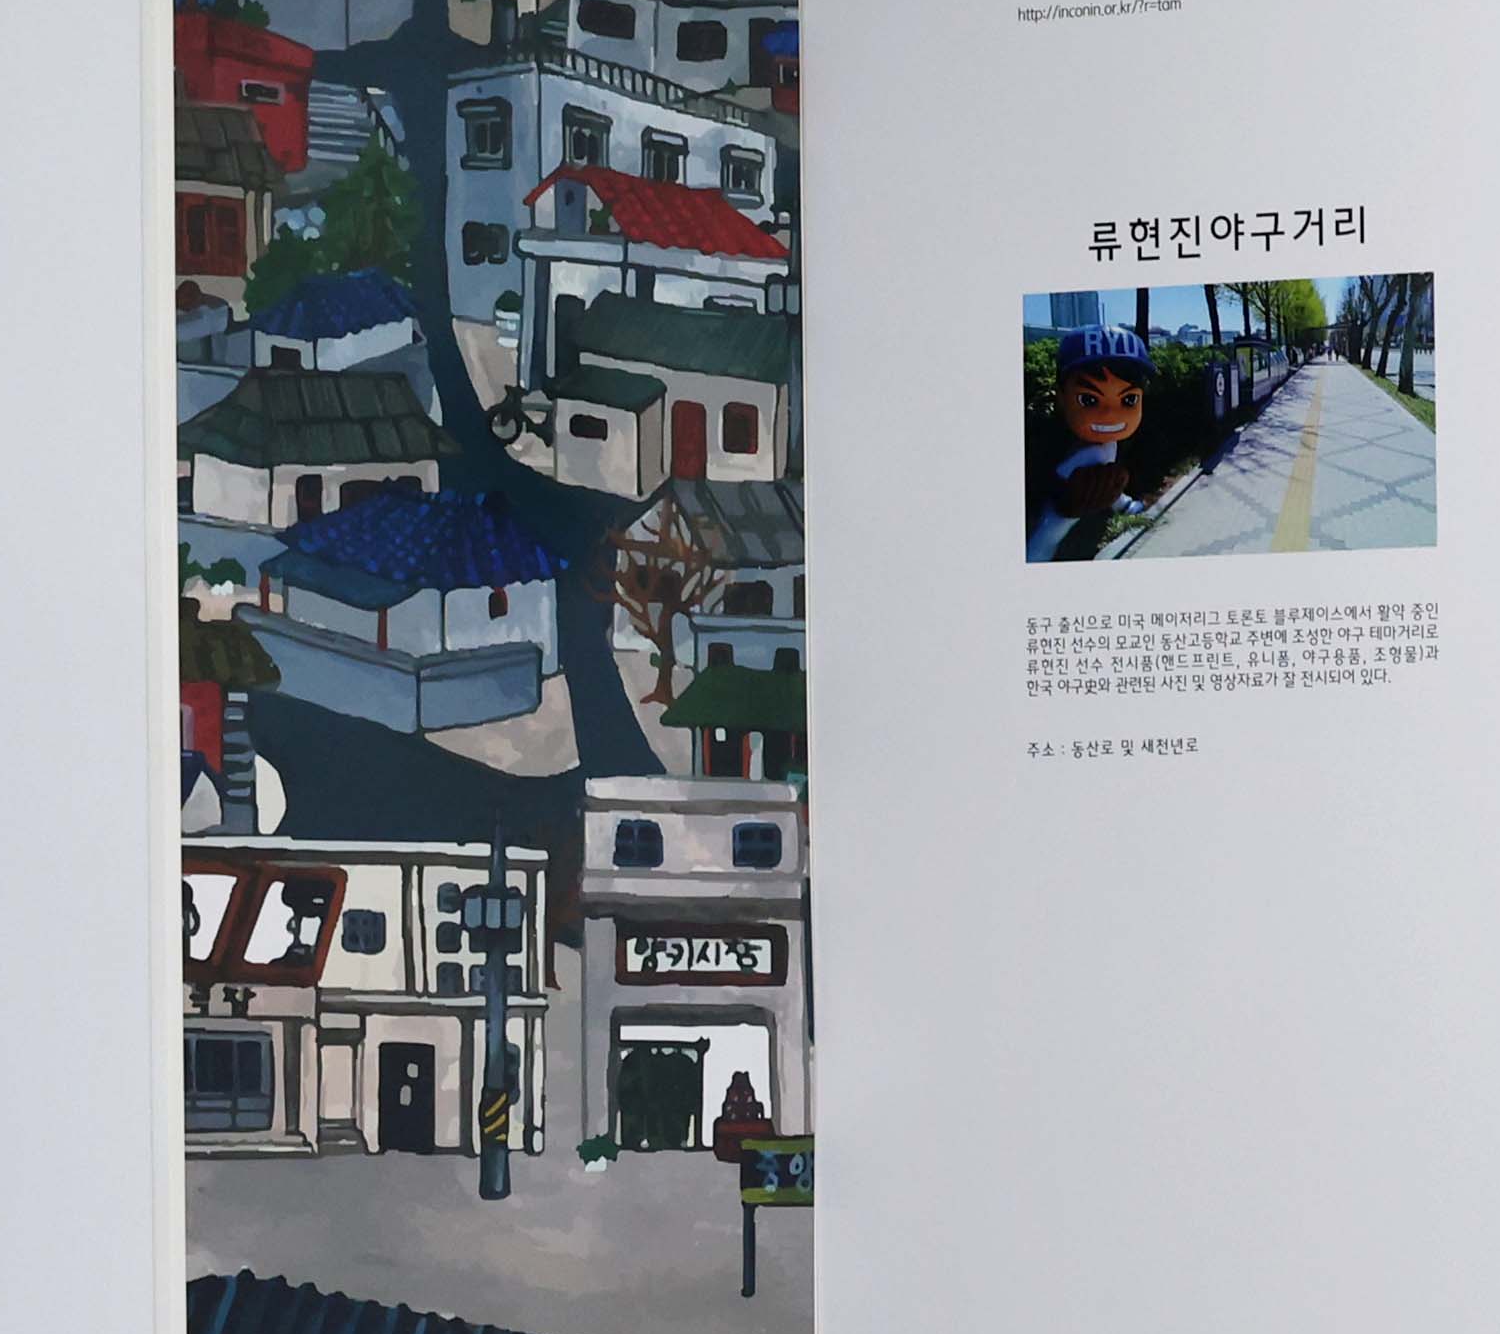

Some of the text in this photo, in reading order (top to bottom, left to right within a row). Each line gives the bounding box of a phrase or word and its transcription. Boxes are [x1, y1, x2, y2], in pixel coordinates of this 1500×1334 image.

[1088, 205, 1365, 262] 류현진야구거리
[1026, 602, 1438, 636] 동구 출신으로 미국 메이저리그 토론토 블루제이스에서 활약 중인
[1027, 741, 1055, 759] 주소
[1071, 739, 1114, 759] 동산로
[1121, 739, 1134, 757] 및
[1141, 737, 1198, 756] 새천년로
